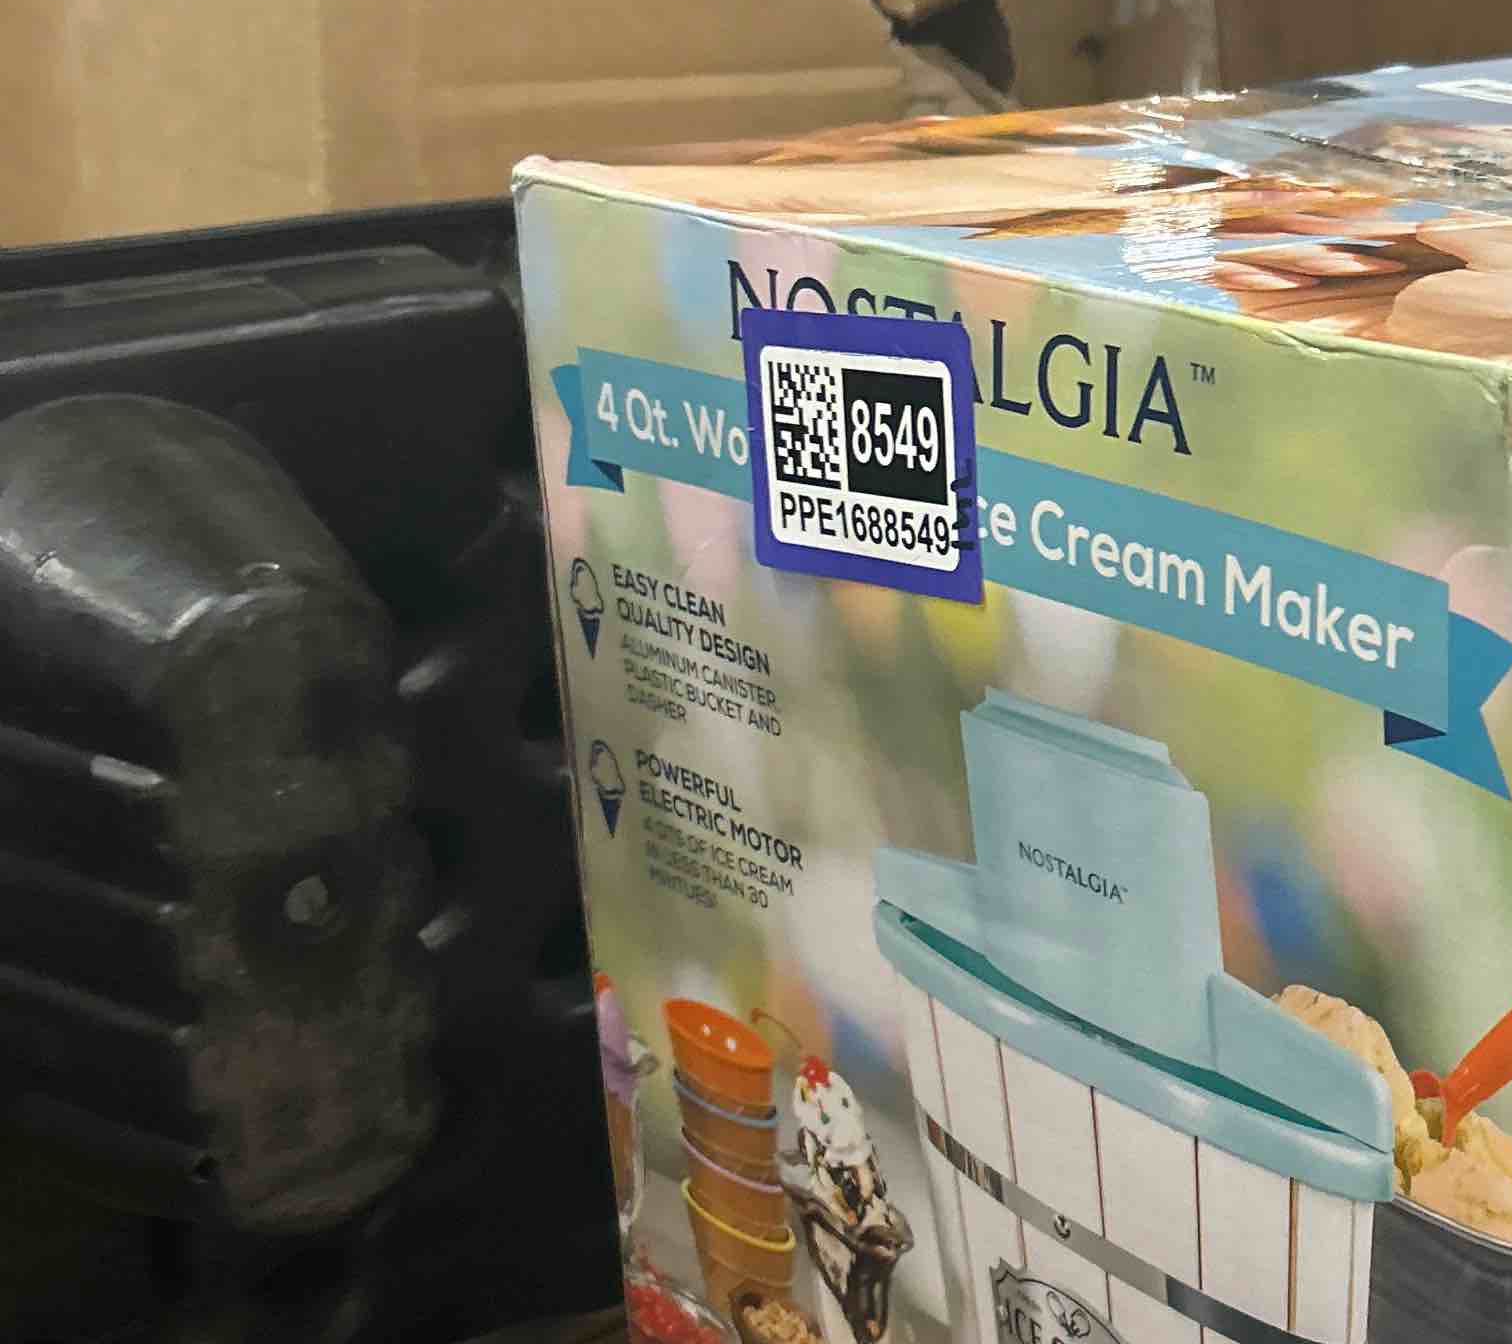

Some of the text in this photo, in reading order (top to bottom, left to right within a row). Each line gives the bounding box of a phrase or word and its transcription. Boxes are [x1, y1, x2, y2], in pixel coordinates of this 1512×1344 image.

[850, 399, 940, 472] 8549
[597, 382, 619, 433] 4
[626, 389, 680, 449] Qt.
[1030, 499, 1206, 606] Cream
[1223, 554, 1415, 669] Maker
[780, 491, 951, 556] PPE1688549
[610, 564, 725, 627] EASY CLEAN
[616, 598, 770, 676] QUALITY DESIGN
[686, 683, 744, 721] BUCKET
[748, 709, 782, 736] AND
[634, 748, 741, 812] POWERFUL
[640, 780, 803, 871] ELECTRIC MOTOR
[711, 844, 735, 870] ICE
[738, 856, 794, 896] CREAM
